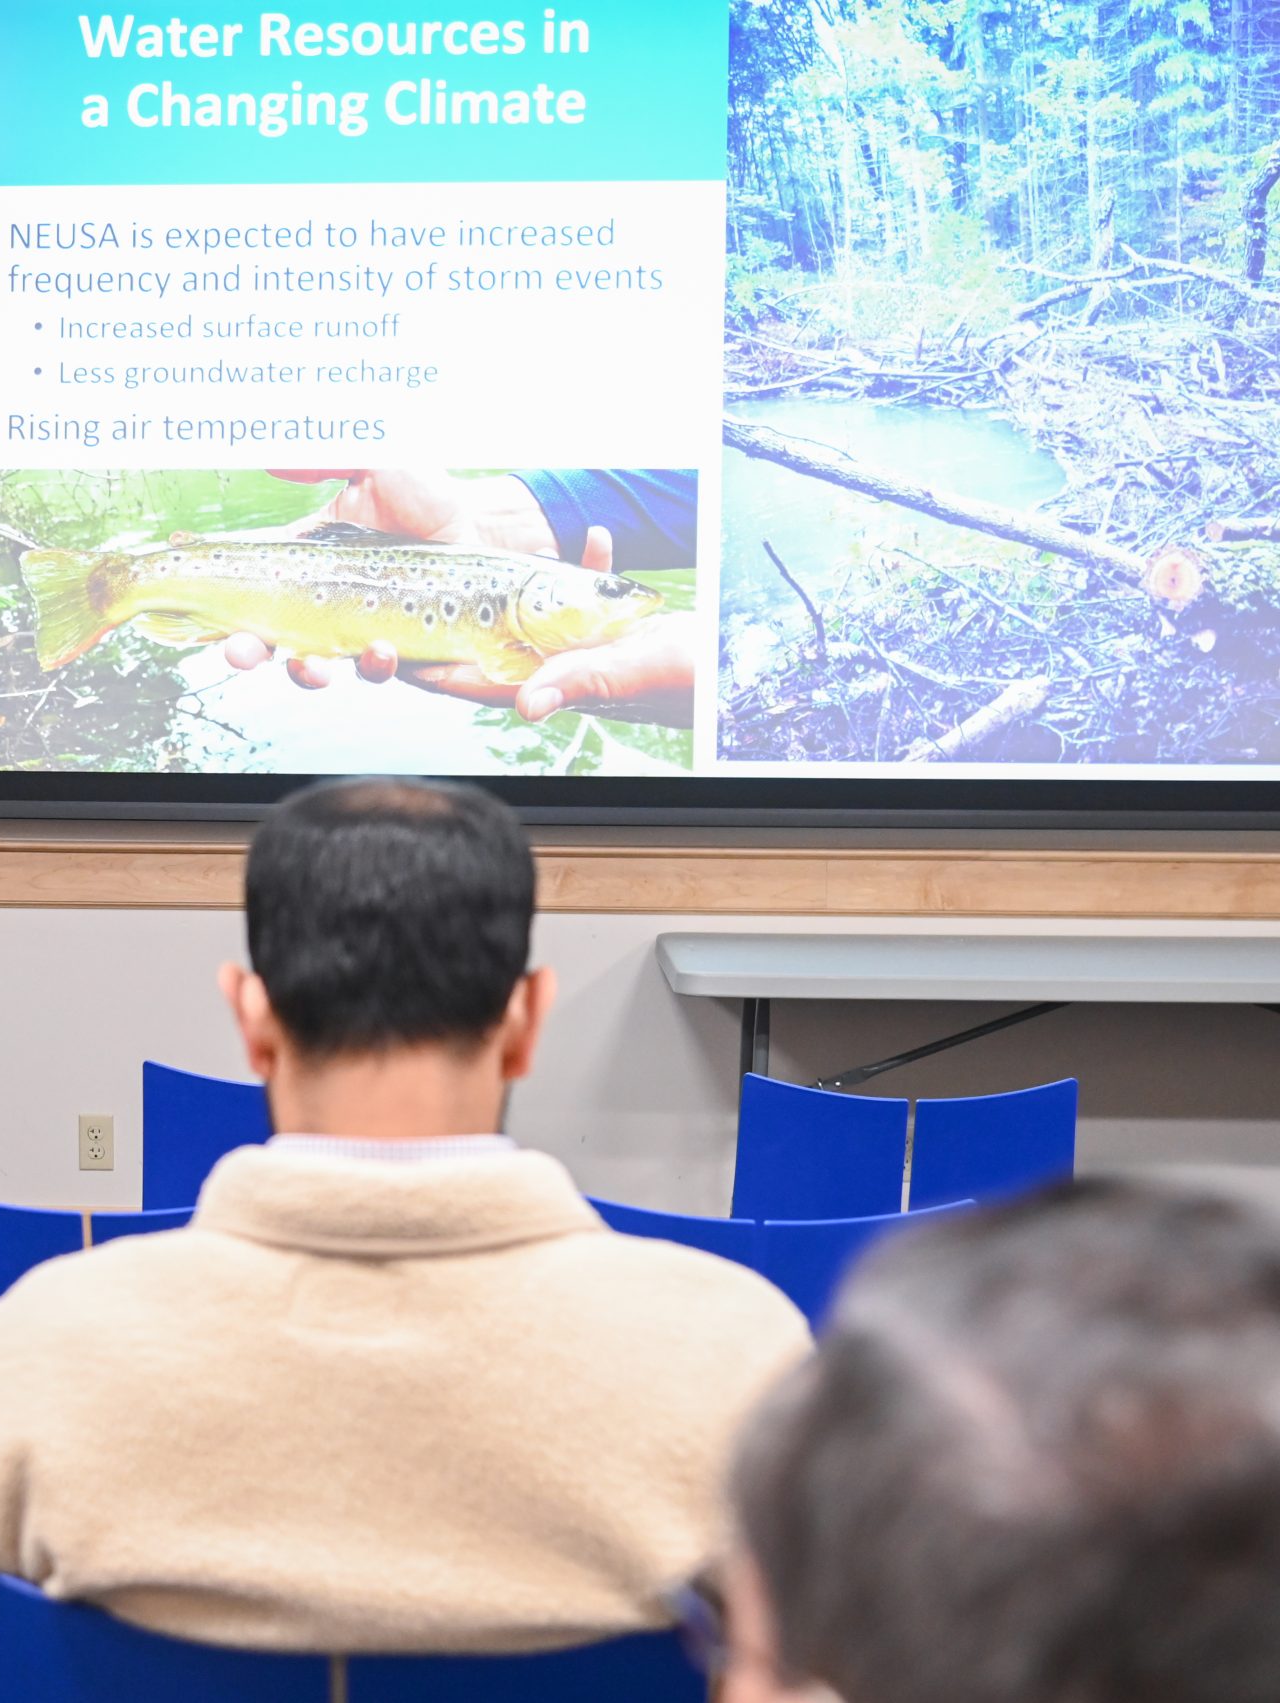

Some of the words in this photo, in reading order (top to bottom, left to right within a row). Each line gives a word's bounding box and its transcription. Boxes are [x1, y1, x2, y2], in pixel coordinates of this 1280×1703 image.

[78, 15, 244, 58] Water
[259, 13, 527, 57] Resources
[543, 9, 590, 53] in
[80, 95, 110, 128] a
[126, 81, 370, 138] Changing
[384, 78, 587, 126] Climate
[9, 221, 121, 250] NEUSA
[131, 221, 155, 249] is
[164, 219, 314, 255] expected
[323, 221, 359, 248] to
[369, 218, 447, 248] have
[458, 217, 616, 247] increased
[6, 263, 172, 300] frequency
[181, 263, 241, 293] and
[253, 264, 395, 298] intensity
[404, 261, 439, 292] of
[447, 265, 544, 292] storm
[554, 265, 664, 291] events
[59, 314, 193, 339] Increased
[202, 313, 304, 338] surface
[313, 313, 401, 338] runoff
[59, 361, 116, 384] Less
[123, 359, 304, 390] groundwater
[315, 359, 439, 388] recharge
[7, 413, 102, 447] Rising
[110, 413, 153, 441] air
[161, 414, 387, 447] temperatures
